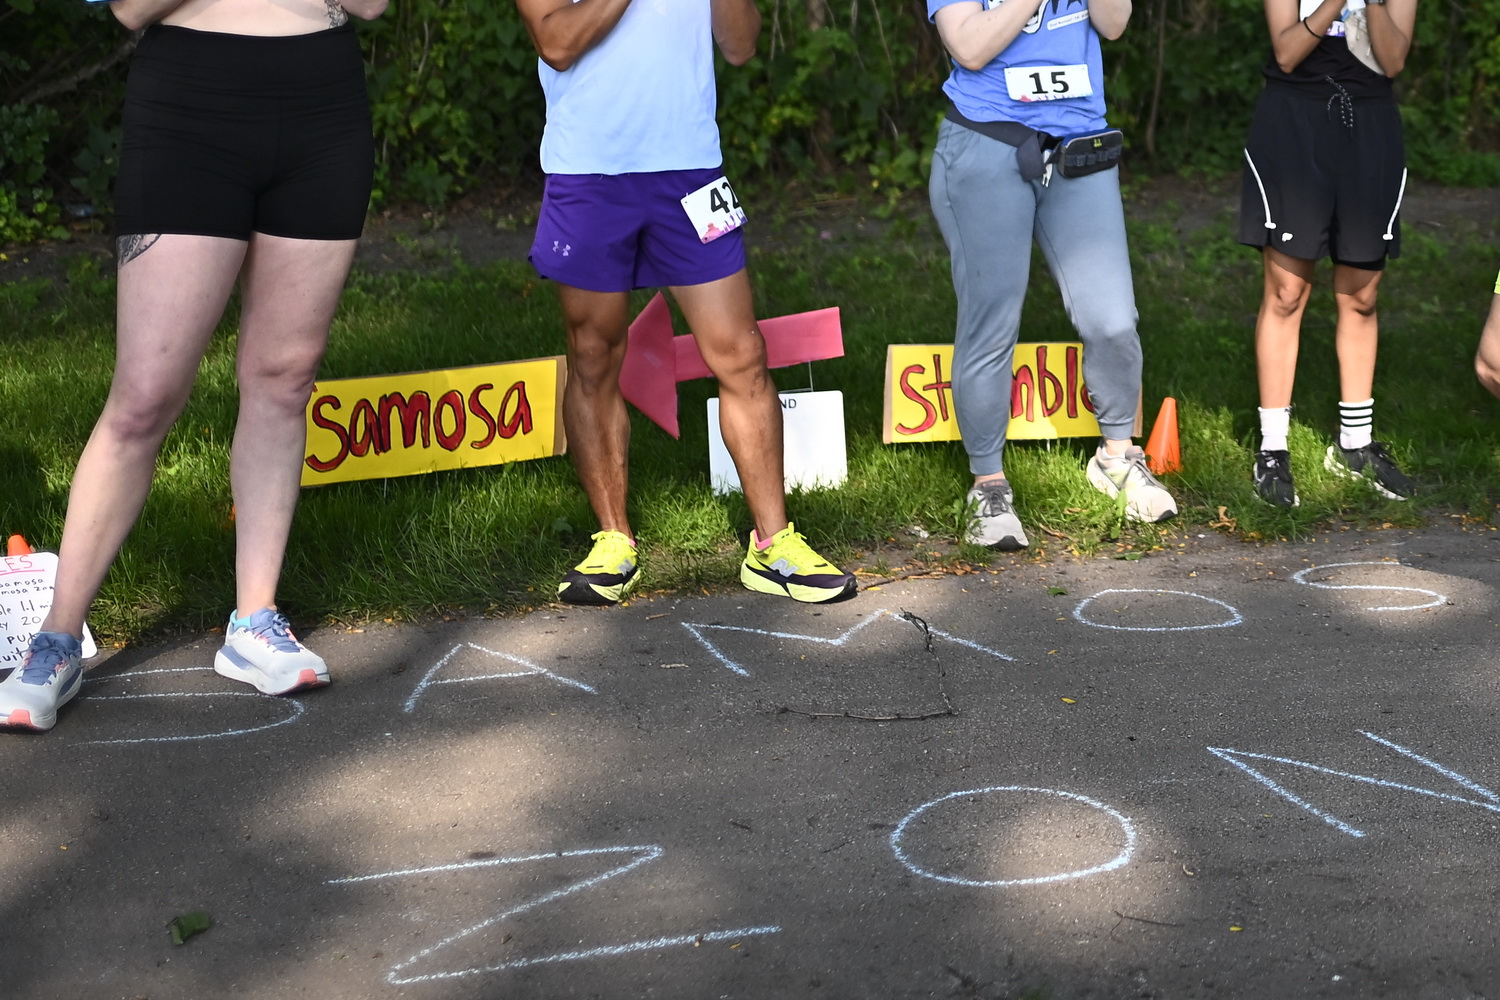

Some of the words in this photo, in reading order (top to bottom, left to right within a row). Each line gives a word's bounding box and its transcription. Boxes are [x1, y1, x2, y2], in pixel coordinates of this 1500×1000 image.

[1028, 71, 1070, 95] 15
[709, 181, 741, 214] 42
[0, 554, 33, 572] ES
